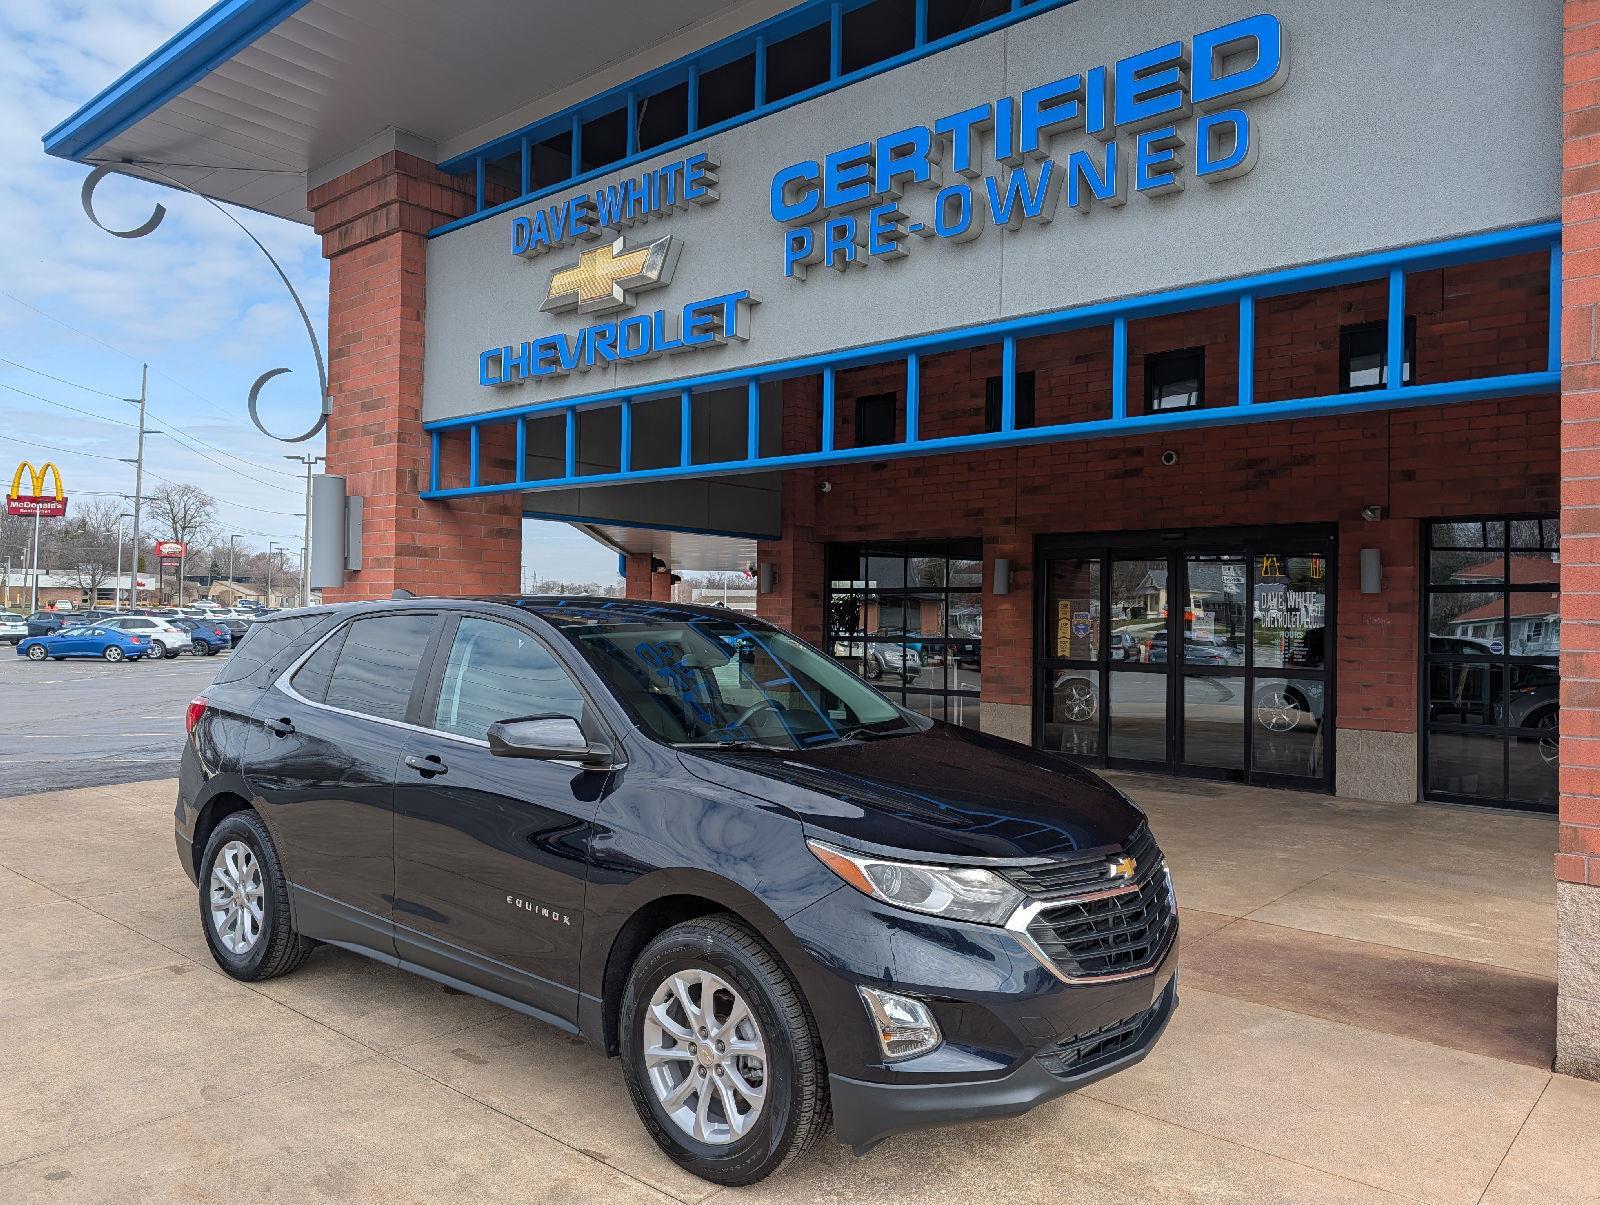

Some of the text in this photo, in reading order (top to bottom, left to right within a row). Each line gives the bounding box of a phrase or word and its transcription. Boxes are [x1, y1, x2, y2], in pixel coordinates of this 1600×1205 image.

[770, 13, 1283, 223] CERTIFIED
[511, 152, 709, 256] DAVE WHITE
[784, 109, 1251, 278] PRE-OWNED
[479, 290, 750, 387] CHEVROLET
[10, 501, 62, 509] McDonald's
[1287, 591, 1317, 609] WHITE
[1280, 630, 1304, 639] HOURS
[506, 895, 571, 926] EQUINOX
